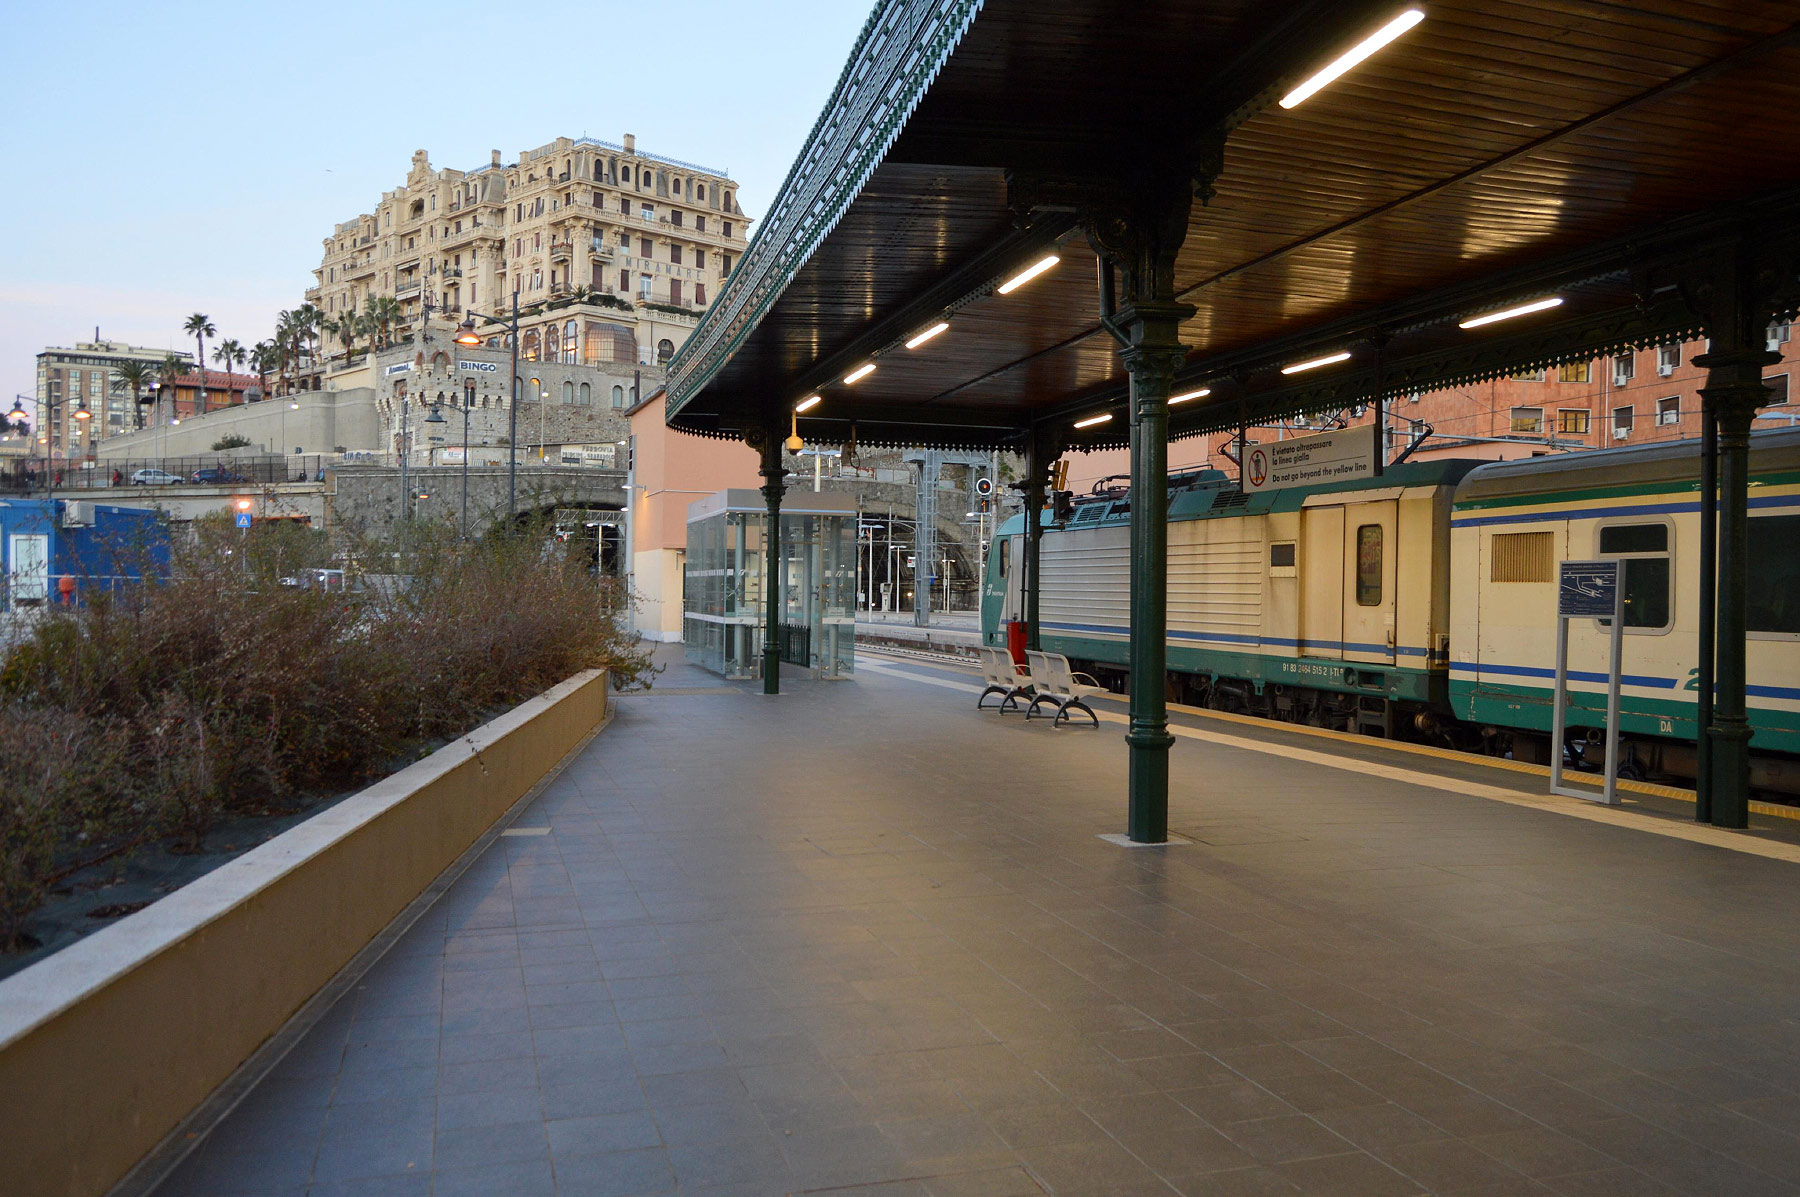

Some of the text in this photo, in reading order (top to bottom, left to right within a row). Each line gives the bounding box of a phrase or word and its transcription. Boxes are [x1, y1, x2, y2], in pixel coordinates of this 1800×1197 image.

[626, 256, 701, 280] MIRAMARE
[460, 362, 496, 372] BINGO
[1272, 440, 1332, 456] È vietato oltrepassare
[1272, 454, 1309, 466] la linea gialla
[1281, 473, 1290, 481] not
[1291, 473, 1298, 482] go
[1300, 469, 1320, 480] beyond
[1323, 467, 1332, 476] the
[1334, 464, 1353, 477] yellow
[1355, 463, 1367, 472] line
[1282, 663, 1289, 671] 91
[1290, 664, 1296, 672] 83
[1661, 721, 1672, 732] DA
